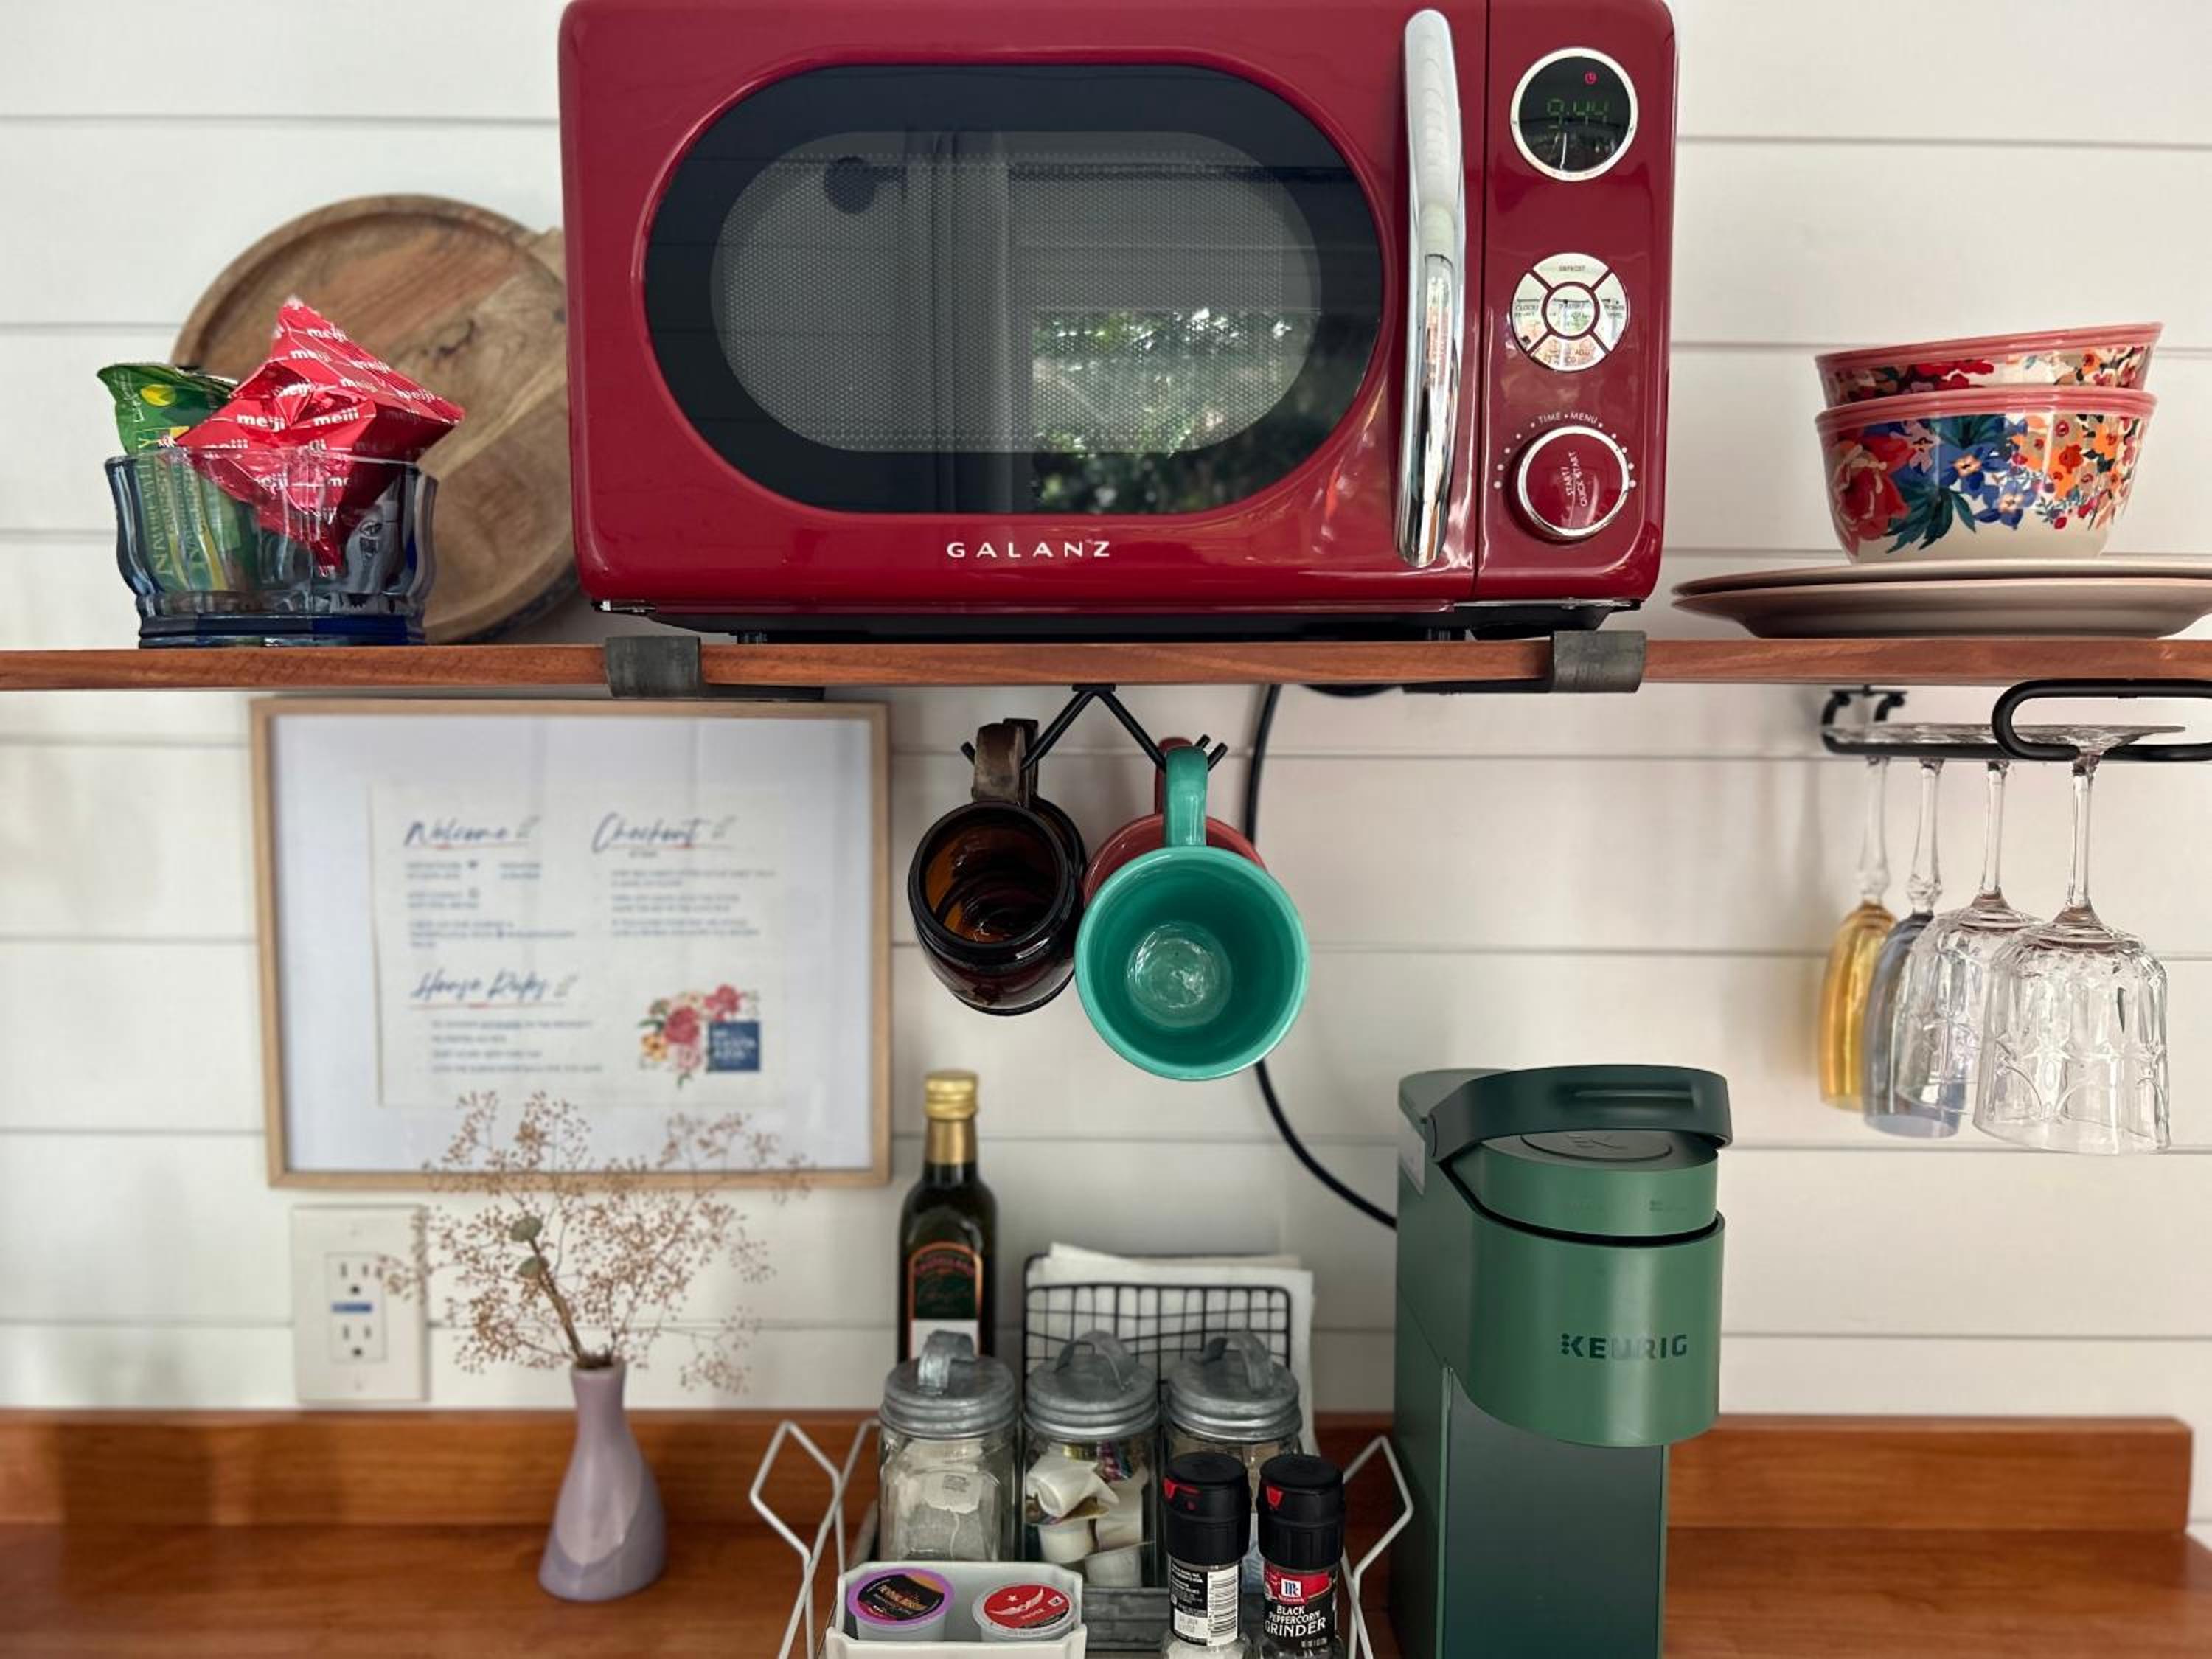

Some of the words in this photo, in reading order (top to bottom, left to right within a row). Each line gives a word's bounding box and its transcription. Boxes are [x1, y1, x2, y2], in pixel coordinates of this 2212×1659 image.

[237, 414, 285, 432] meiji
[313, 406, 359, 427] meiji
[1538, 412, 1561, 424] TIME
[1570, 412, 1599, 425] MENU
[946, 541, 1110, 558] GALANZ
[1562, 1334, 1688, 1360] KEURIG
[1269, 1610, 1321, 1624] PEPPERCORN
[1277, 1605, 1306, 1615] BLACK
[1265, 1617, 1326, 1638] GRINDER
